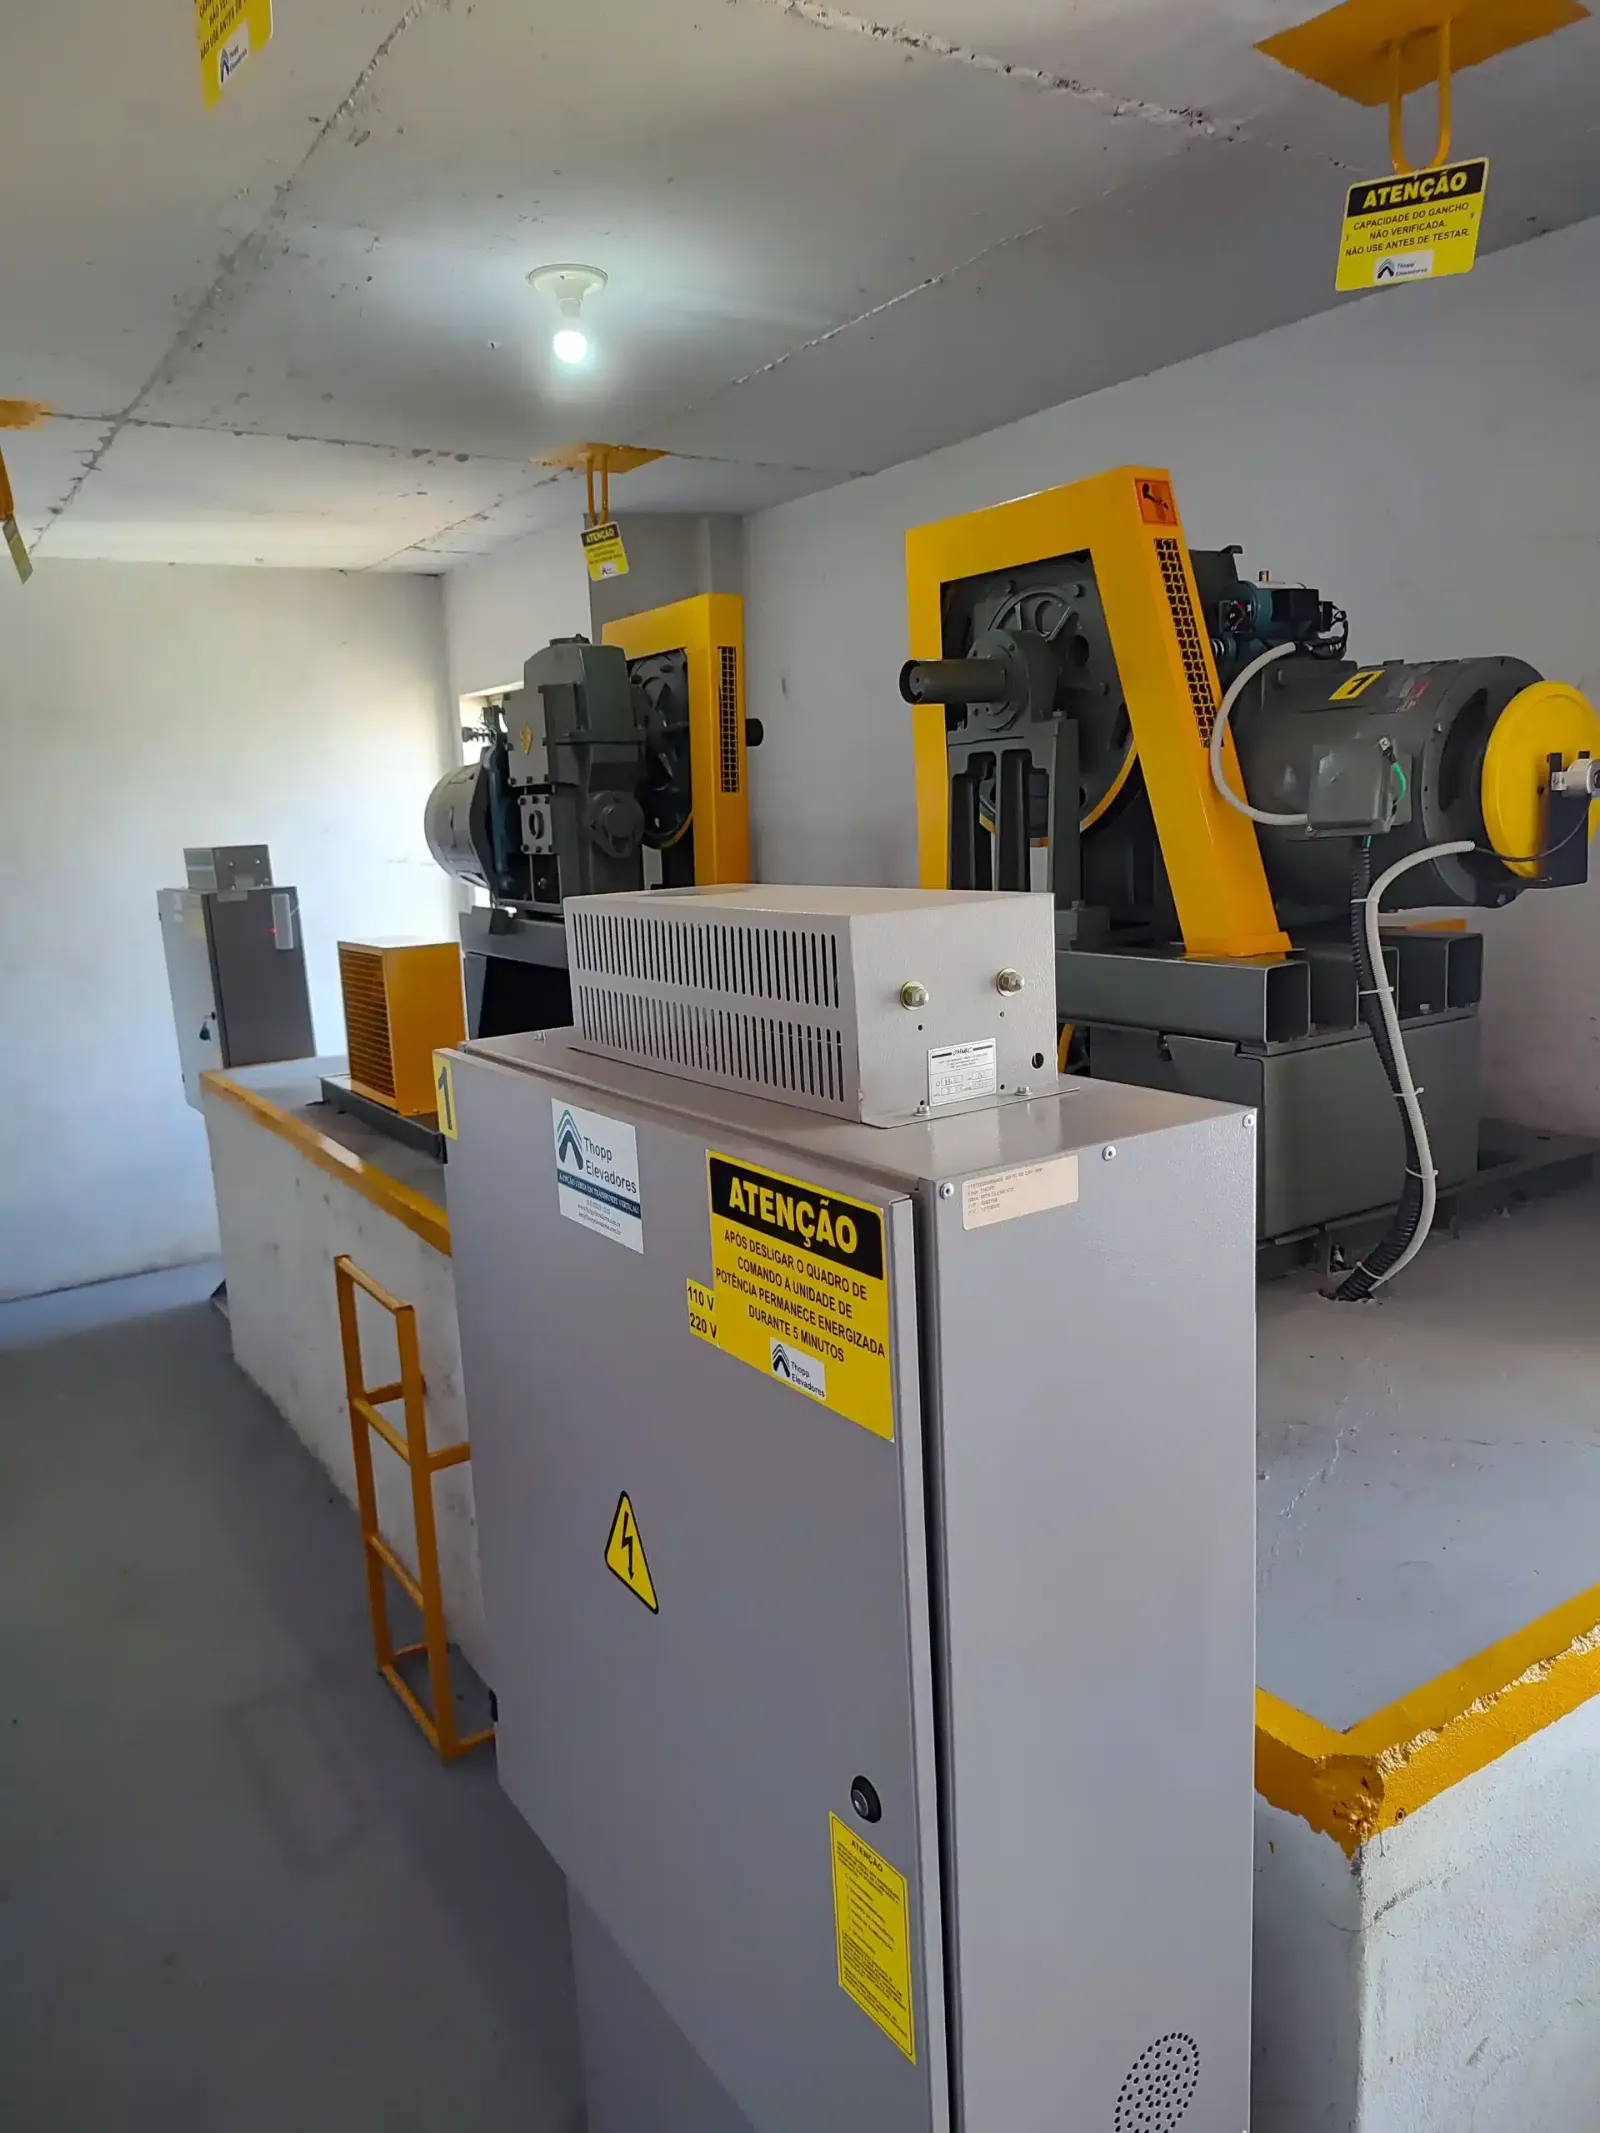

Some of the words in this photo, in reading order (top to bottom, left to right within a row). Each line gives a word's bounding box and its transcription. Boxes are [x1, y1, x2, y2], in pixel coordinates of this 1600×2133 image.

[1362, 170, 1468, 209] ATENÇÃO
[1353, 214, 1410, 231] CAPACIDADE
[1412, 210, 1426, 219] DO
[1428, 202, 1469, 217] GANCHO
[1369, 228, 1389, 240] NÃO
[1391, 219, 1447, 236] VERIFICADA.
[1345, 244, 1364, 257] NÃO
[1366, 243, 1383, 253] USE
[1385, 238, 1415, 250] ANTES
[1417, 235, 1429, 244] DE
[1347, 673, 1375, 695] 1
[438, 1066, 452, 1130] 1
[583, 1136, 612, 1163] Thopp
[586, 1160, 637, 1194] Elevadores
[728, 1176, 858, 1254] ATENÇÃO
[724, 1229, 748, 1250] APÓS
[749, 1239, 794, 1270] DESLIGAR
[797, 1259, 804, 1274] O
[806, 1264, 850, 1293] QUADRO
[852, 1281, 867, 1301] DE
[688, 1286, 704, 1307] 110
[707, 1294, 714, 1311] V
[737, 1256, 782, 1287] COMANDO
[784, 1278, 791, 1292] A
[793, 1281, 836, 1311] UNIDADE
[838, 1301, 853, 1319] DE
[690, 1312, 707, 1334] 220
[709, 1322, 717, 1339] V
[716, 1267, 757, 1298] POTÊNCIA
[759, 1287, 816, 1326] PERMANECE
[818, 1314, 886, 1358] ENERGIZADA
[748, 1304, 791, 1336] DURANTE
[793, 1328, 799, 1340] 5
[800, 1329, 845, 1363] MINUTOS
[791, 1361, 810, 1378] Thopp
[791, 1374, 825, 1398] Elevadores
[852, 1840, 883, 1873] ATENÇÃO
